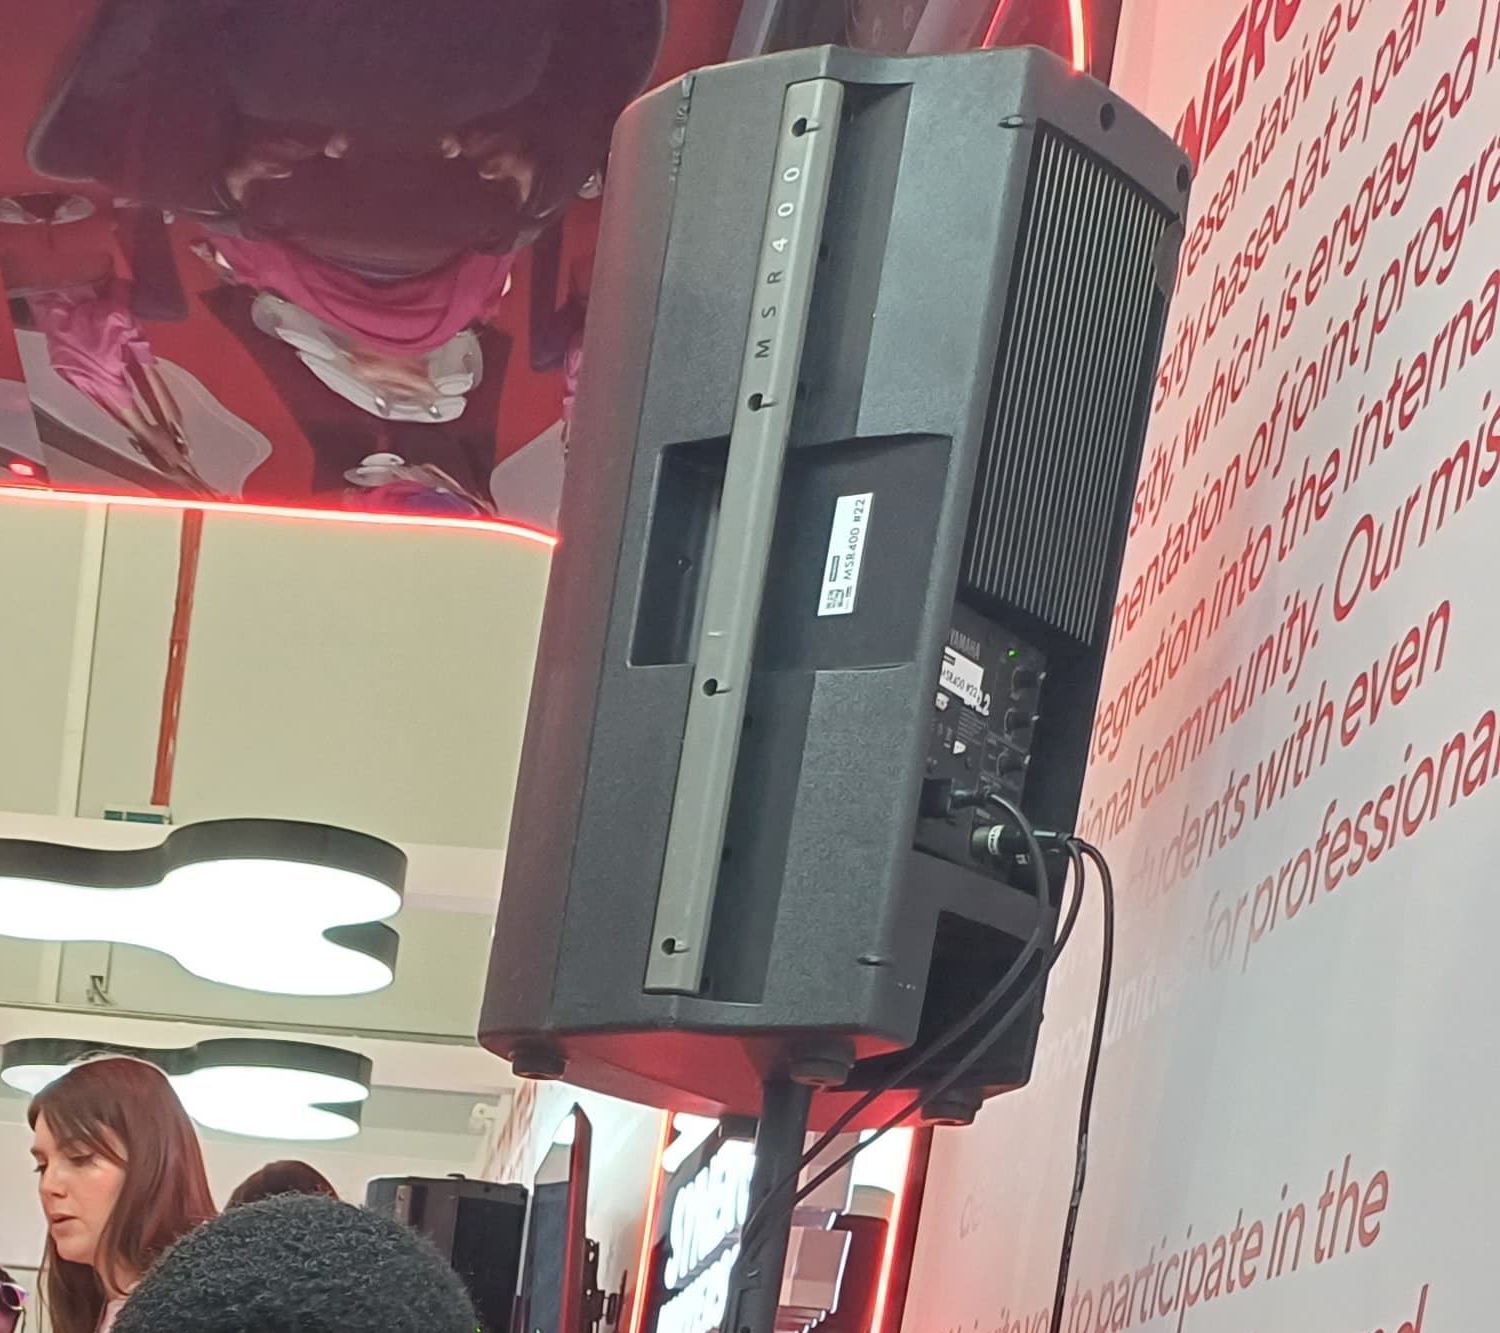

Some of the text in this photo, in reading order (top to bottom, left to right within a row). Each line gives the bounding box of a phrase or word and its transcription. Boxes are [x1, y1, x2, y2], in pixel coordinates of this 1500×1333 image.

[1172, 0, 1301, 182] NER
[754, 166, 800, 359] MSR400
[1155, 302, 1206, 413] sity
[1203, 140, 1302, 346] based
[1299, 96, 1338, 209] at
[1338, 76, 1363, 152] a
[1183, 298, 1270, 468] which
[1273, 262, 1302, 351] is
[1305, 0, 1488, 306] engaged
[1244, 369, 1290, 489] of
[1273, 279, 1368, 479] joint
[843, 527, 860, 580] MSR400
[1207, 523, 1272, 640] into
[1277, 447, 1340, 562] the
[1141, 583, 1324, 809] community.
[1333, 484, 1422, 622] Our
[1130, 600, 1451, 901] tudents with even
[1266, 1184, 1305, 1282] in
[1313, 1154, 1389, 1266] the
